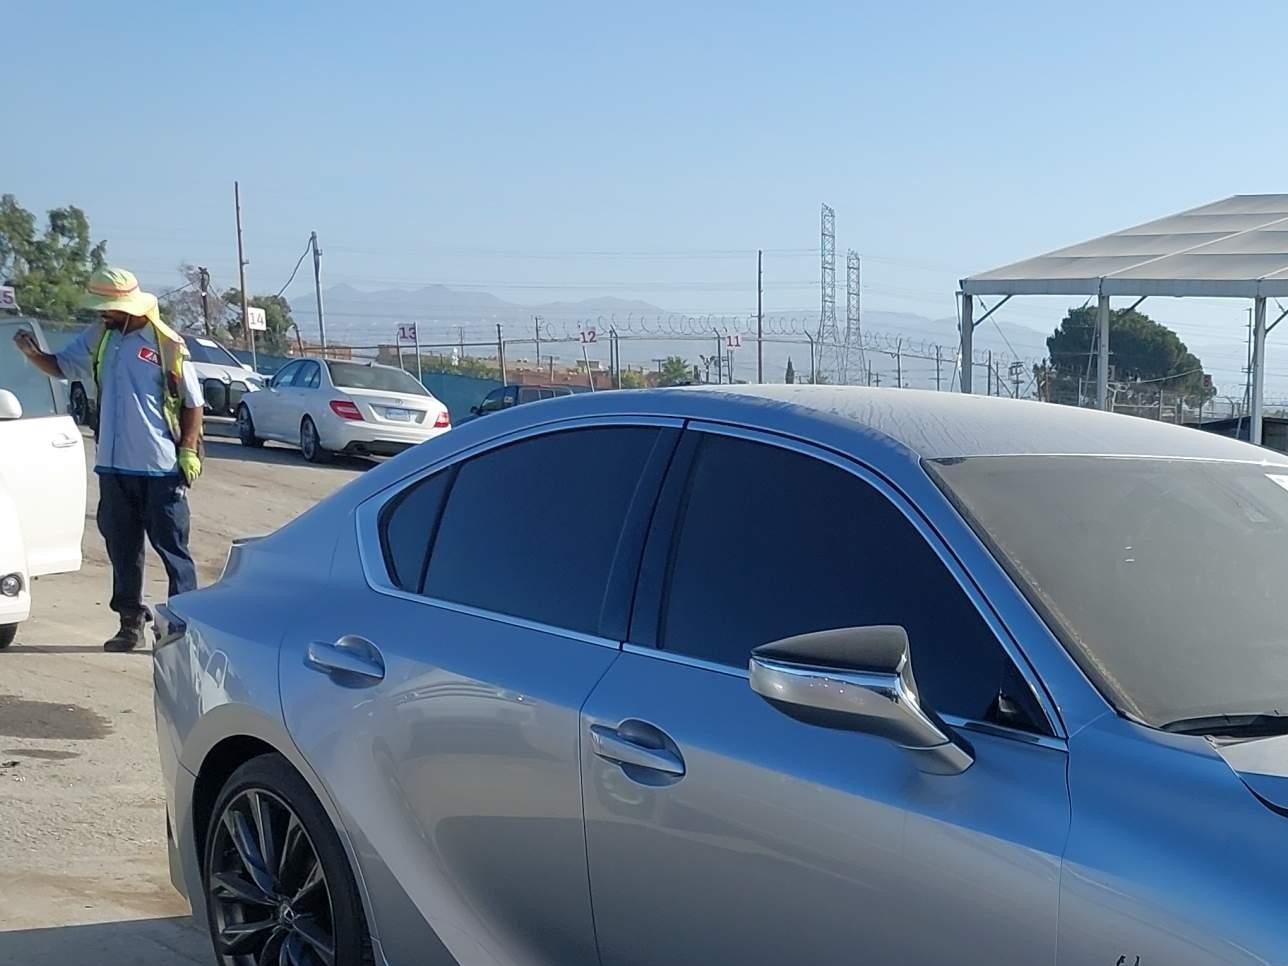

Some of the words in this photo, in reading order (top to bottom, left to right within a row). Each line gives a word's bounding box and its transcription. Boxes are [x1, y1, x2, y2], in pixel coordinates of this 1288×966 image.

[0, 290, 14, 304] 5
[249, 312, 264, 326] 14
[399, 327, 416, 340] 13
[580, 330, 597, 343] 12
[727, 335, 741, 347] 11
